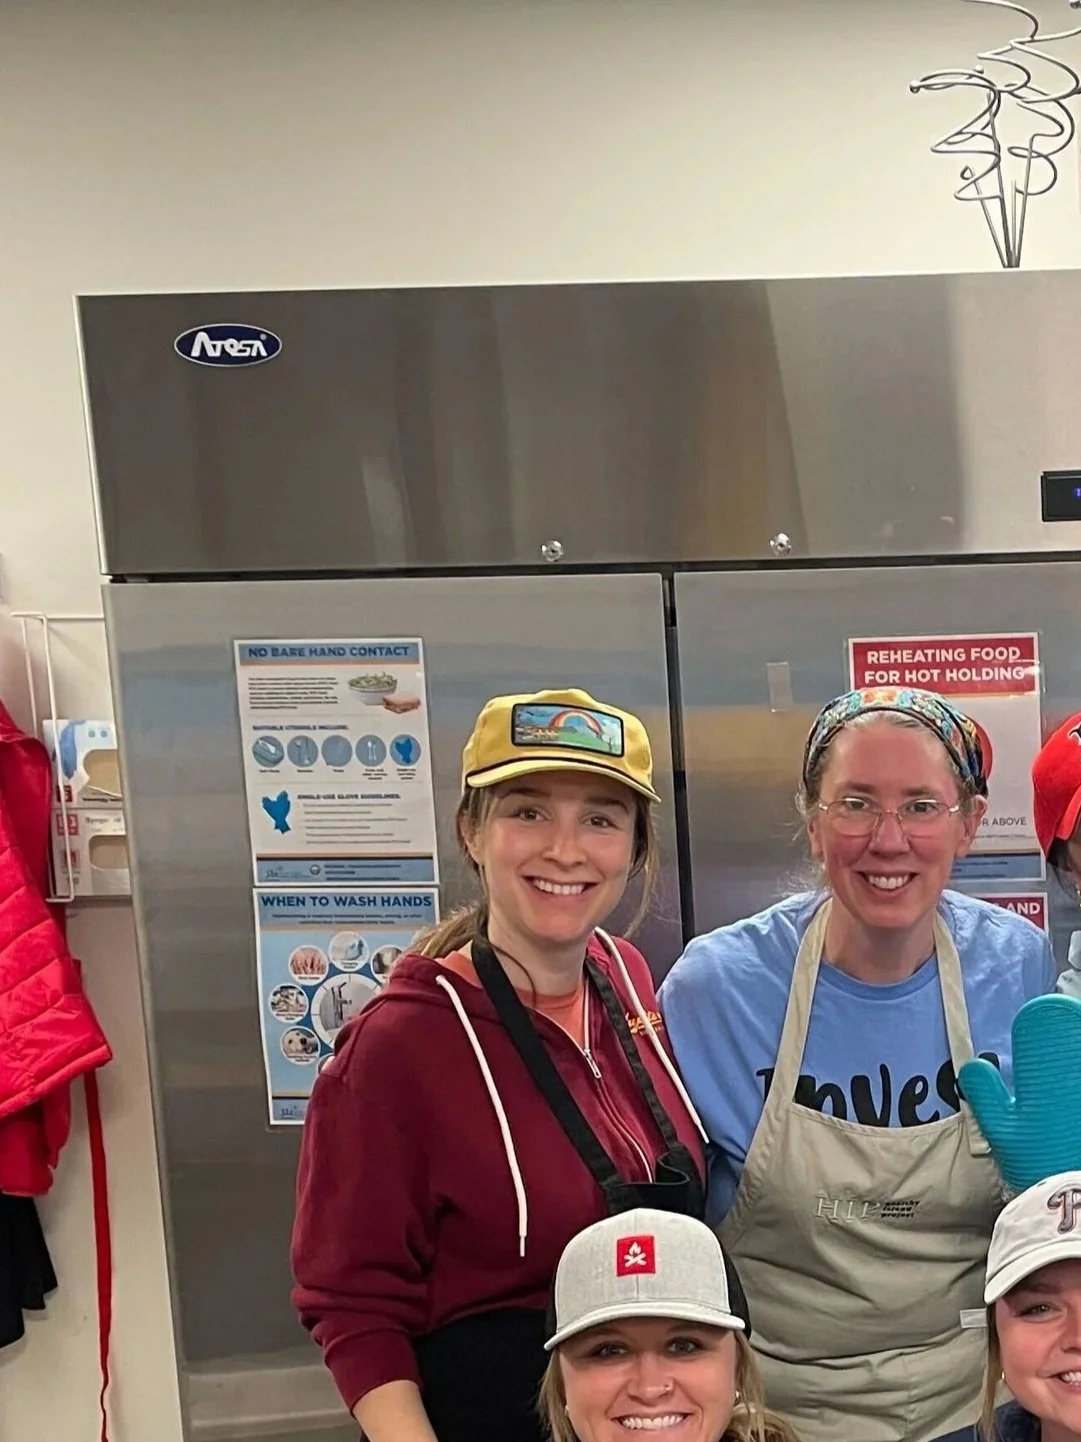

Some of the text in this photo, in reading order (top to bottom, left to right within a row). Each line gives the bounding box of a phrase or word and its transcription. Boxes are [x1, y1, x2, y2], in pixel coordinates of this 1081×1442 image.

[248, 645, 409, 657] NO BARE HAND CONTACT
[867, 646, 1021, 665] REHEATING FOOD
[864, 666, 1025, 684] FOR HOT HOLDING
[992, 816, 1027, 826] ABOVE
[261, 895, 432, 907] WHEN TO WASH HANDS
[1006, 902, 1041, 915] AND
